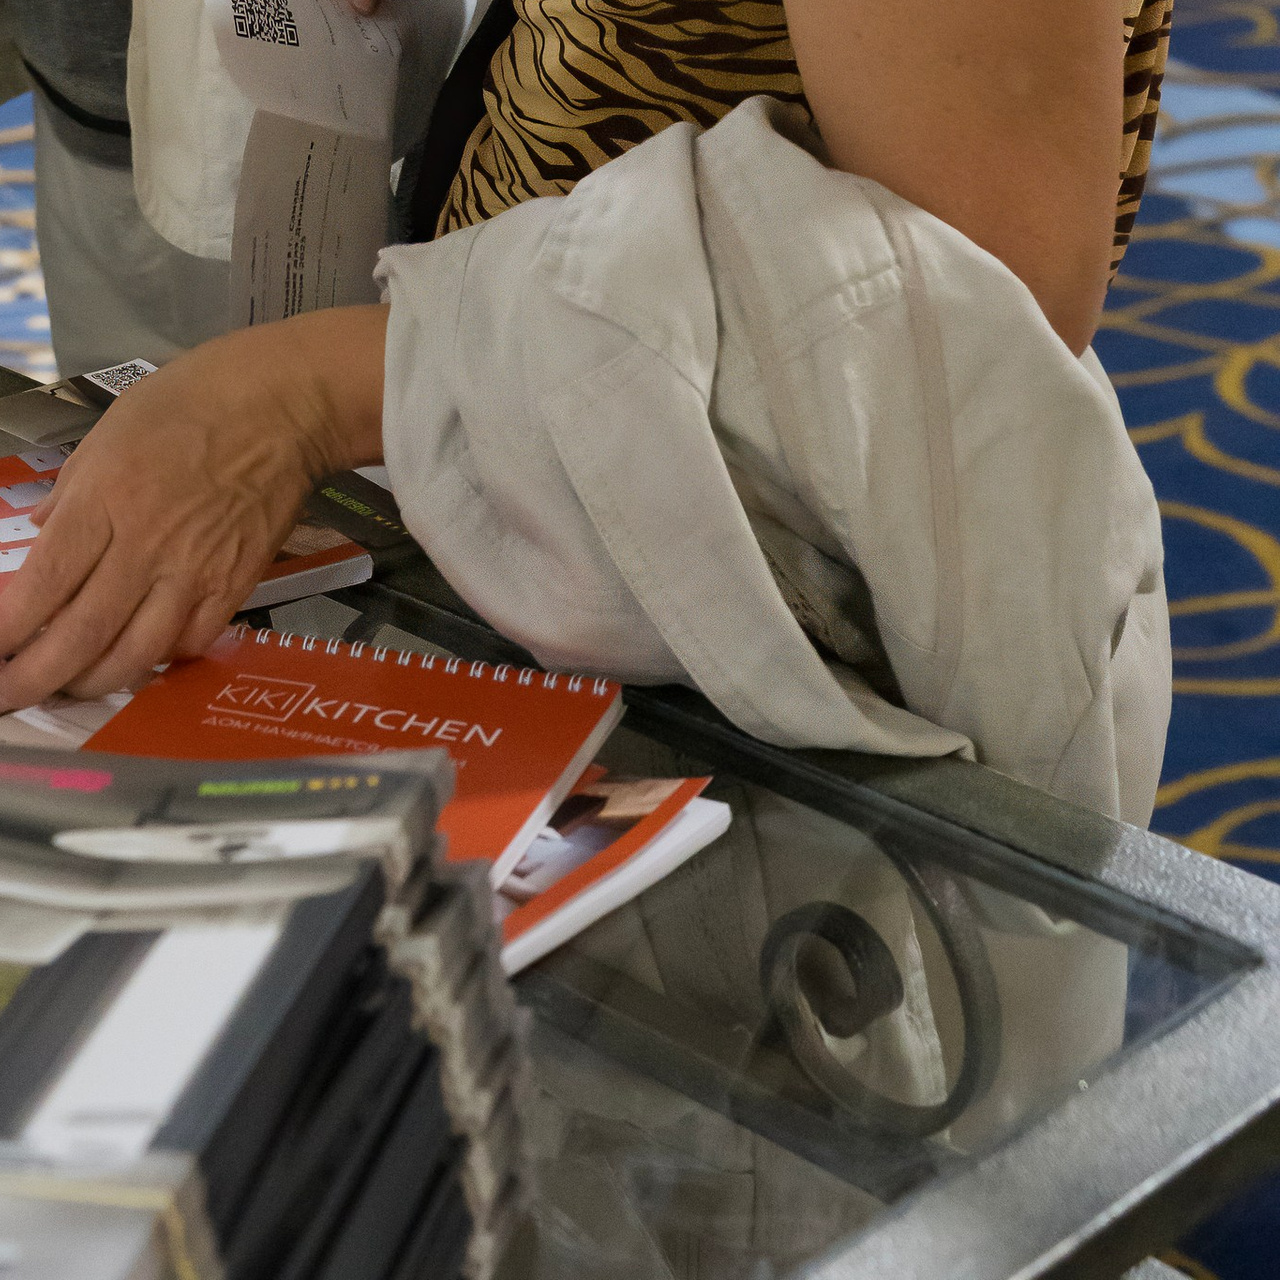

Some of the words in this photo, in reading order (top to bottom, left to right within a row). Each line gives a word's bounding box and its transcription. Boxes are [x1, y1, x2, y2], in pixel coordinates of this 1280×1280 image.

[201, 714, 252, 731] ДОМ
[215, 683, 298, 711] KIKI
[302, 696, 504, 748] KITCHEN
